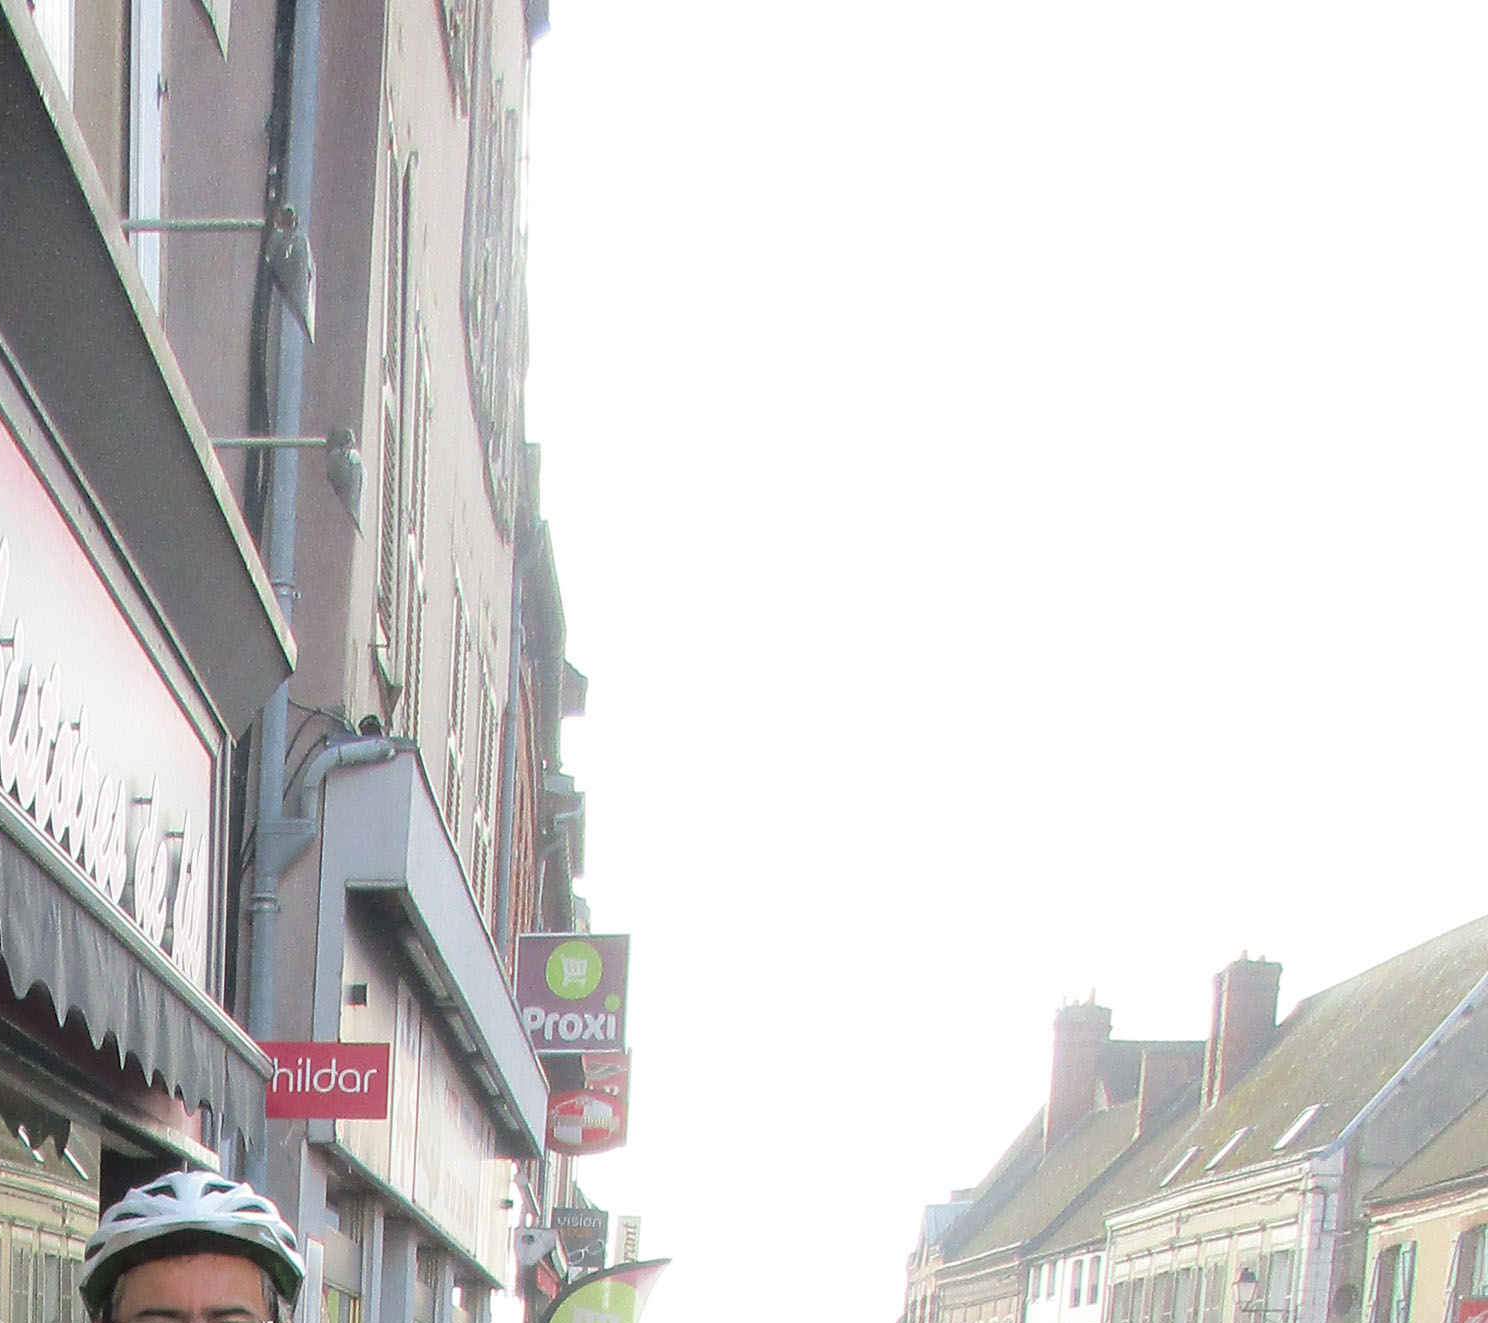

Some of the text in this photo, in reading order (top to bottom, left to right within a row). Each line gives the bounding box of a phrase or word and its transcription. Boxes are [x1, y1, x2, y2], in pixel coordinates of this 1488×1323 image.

[523, 996, 619, 1042] Proxi
[272, 1057, 377, 1094] hildar
[557, 1212, 602, 1228] vision
